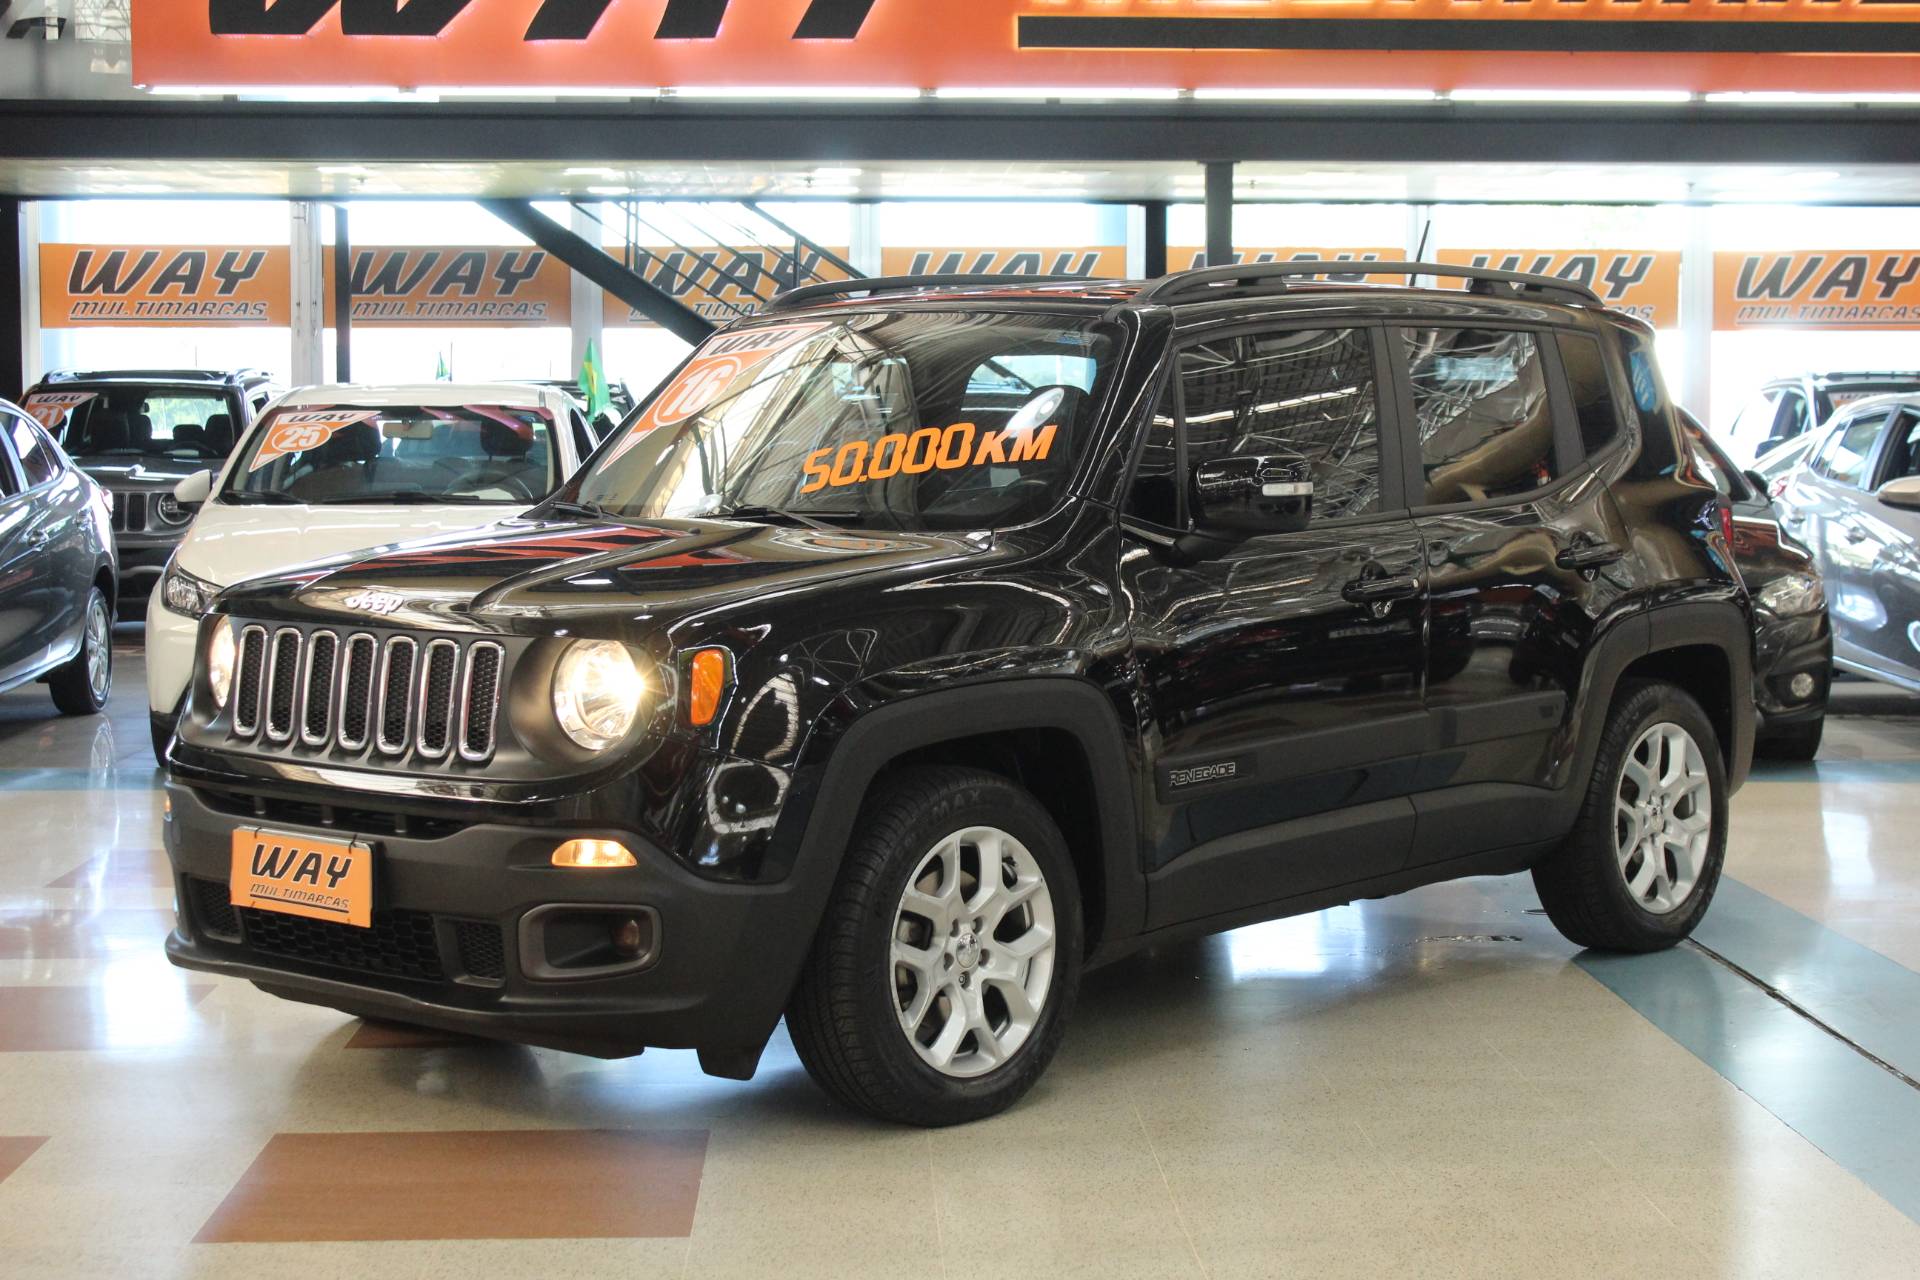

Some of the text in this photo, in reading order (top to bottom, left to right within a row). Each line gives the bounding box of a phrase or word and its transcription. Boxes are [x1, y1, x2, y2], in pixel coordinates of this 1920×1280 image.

[68, 249, 269, 297] WAY
[350, 250, 548, 297] WAY
[1735, 255, 1920, 301] WAY
[69, 301, 269, 317] MULTIMARCAS
[351, 302, 548, 317] MULTIMARCAS
[709, 330, 797, 356] WAY
[662, 364, 735, 417] 16
[288, 413, 358, 422] WAY
[280, 426, 321, 450] 25
[344, 590, 404, 615] Jeep
[1168, 762, 1236, 787] RENEGADE
[250, 842, 353, 890] WAY
[250, 883, 350, 909] MULTIMARCAS
